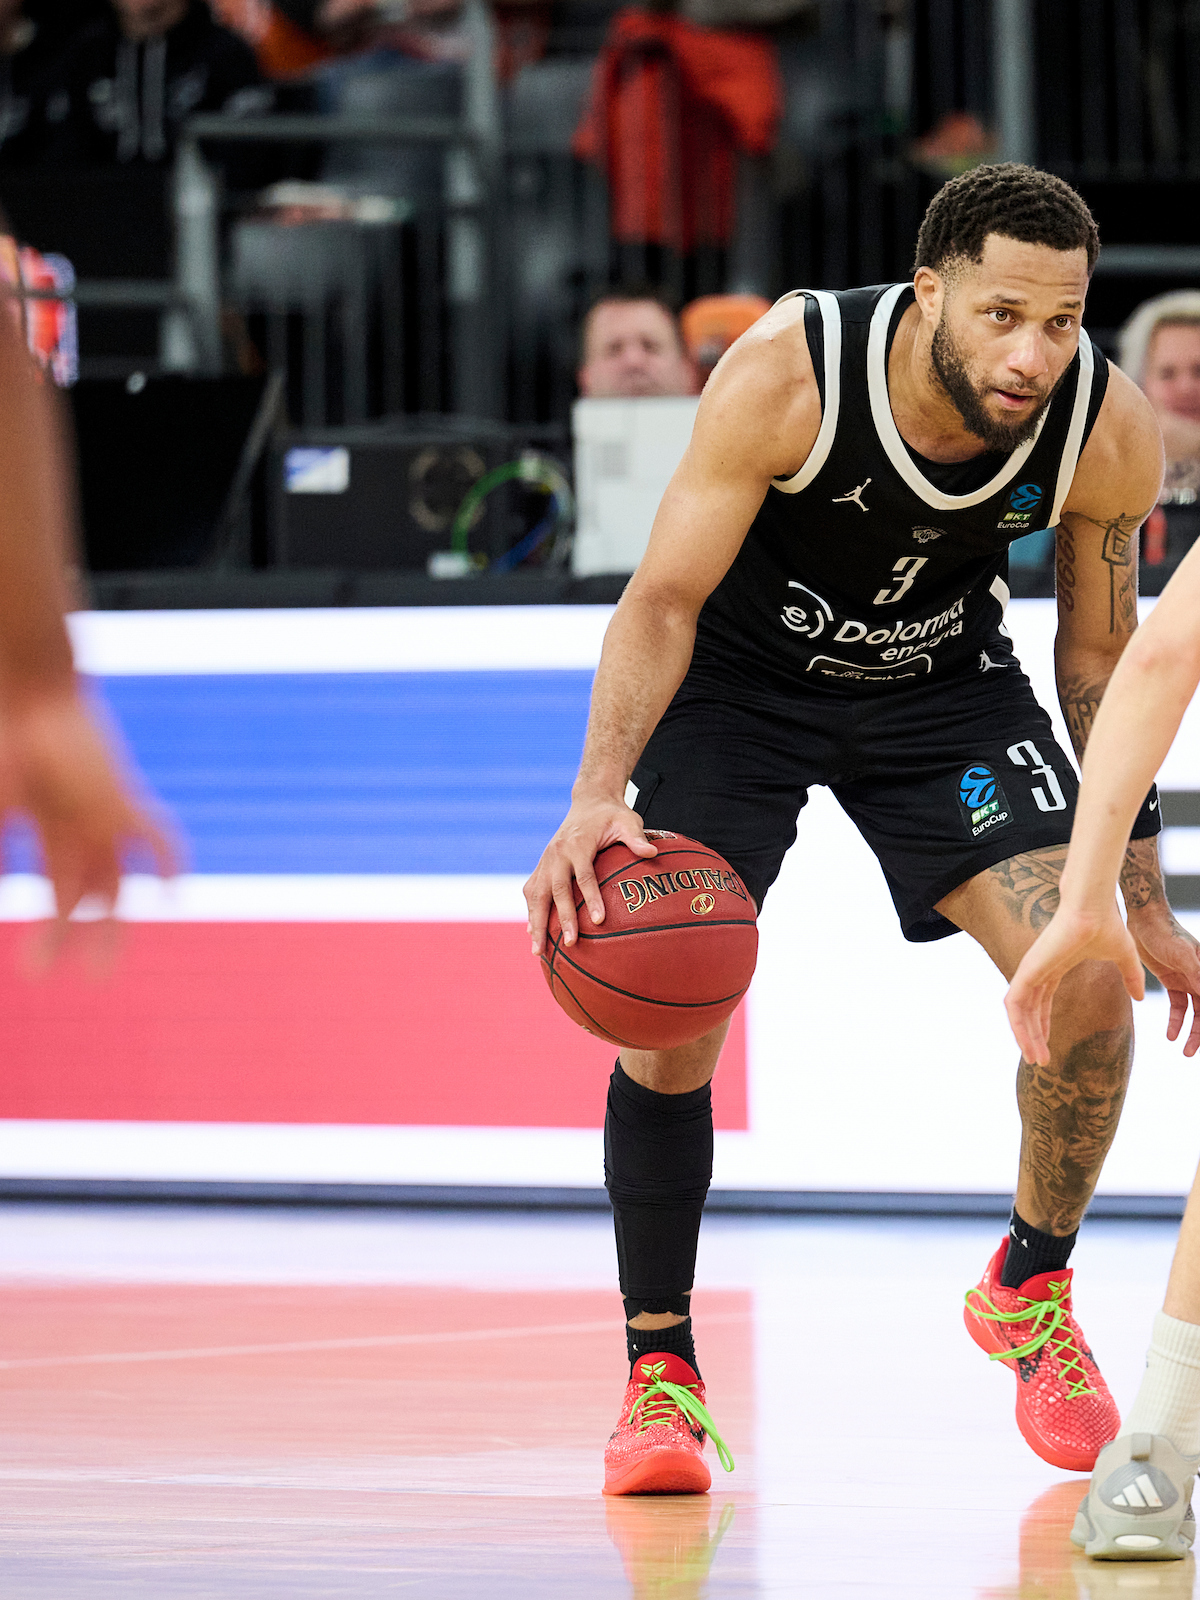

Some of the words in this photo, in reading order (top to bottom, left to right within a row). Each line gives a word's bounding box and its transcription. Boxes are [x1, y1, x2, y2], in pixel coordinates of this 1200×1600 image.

[997, 521, 1030, 529] EuroCup
[1004, 512, 1032, 521] BKT
[873, 556, 929, 606] 3
[1006, 740, 1067, 812] 3
[972, 801, 999, 824] BKT
[972, 811, 1008, 837] EuroCup
